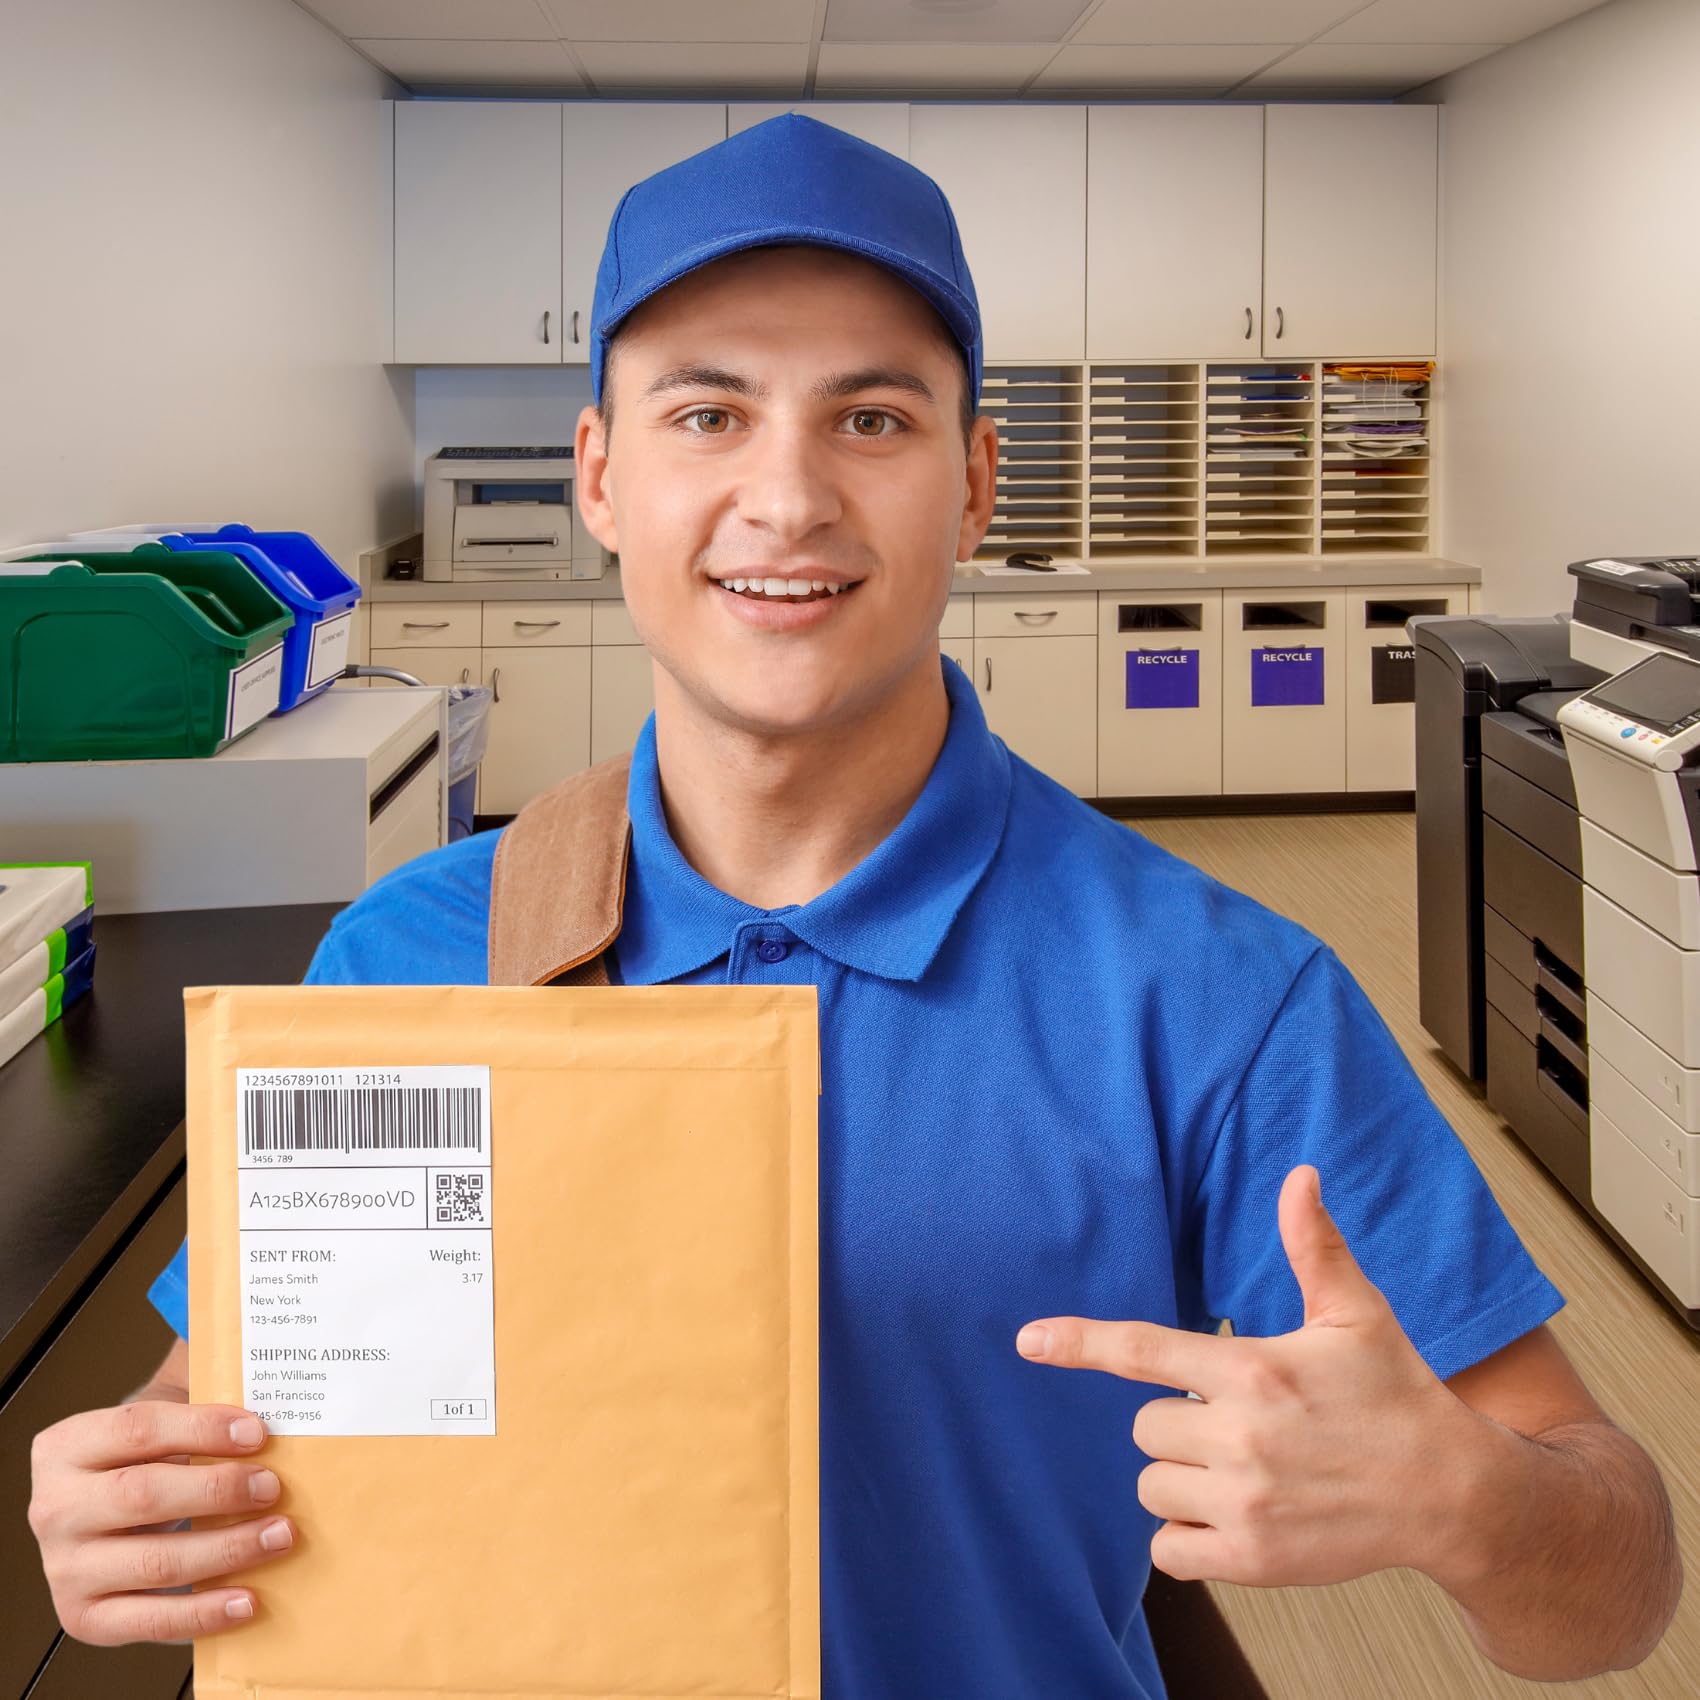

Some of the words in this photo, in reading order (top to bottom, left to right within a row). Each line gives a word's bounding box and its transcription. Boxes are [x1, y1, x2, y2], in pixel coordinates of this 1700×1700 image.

[1137, 654, 1188, 665] RECYCLE
[1262, 652, 1313, 663] RECYCLE
[1388, 651, 1416, 659] TRAS
[245, 1074, 343, 1087] 1234567891011
[355, 1073, 401, 1086] 121314
[252, 1155, 274, 1164] 3456
[277, 1154, 294, 1164] 789
[249, 1190, 415, 1210] A125BX678900VD
[250, 1250, 288, 1263] SENT
[291, 1249, 336, 1263] FROM:
[429, 1248, 481, 1265] Weight:
[248, 1273, 284, 1285] James
[286, 1273, 319, 1285] Smith
[461, 1272, 484, 1284] 3.17
[250, 1295, 275, 1306] New
[277, 1294, 302, 1306] York
[249, 1313, 317, 1326] 123-456-7891
[250, 1348, 317, 1361] SHIPPING
[320, 1348, 390, 1361] ADDRESS:
[251, 1369, 278, 1381] John
[280, 1369, 327, 1381] Williams
[252, 1389, 272, 1401] San
[275, 1389, 325, 1401] Francisco
